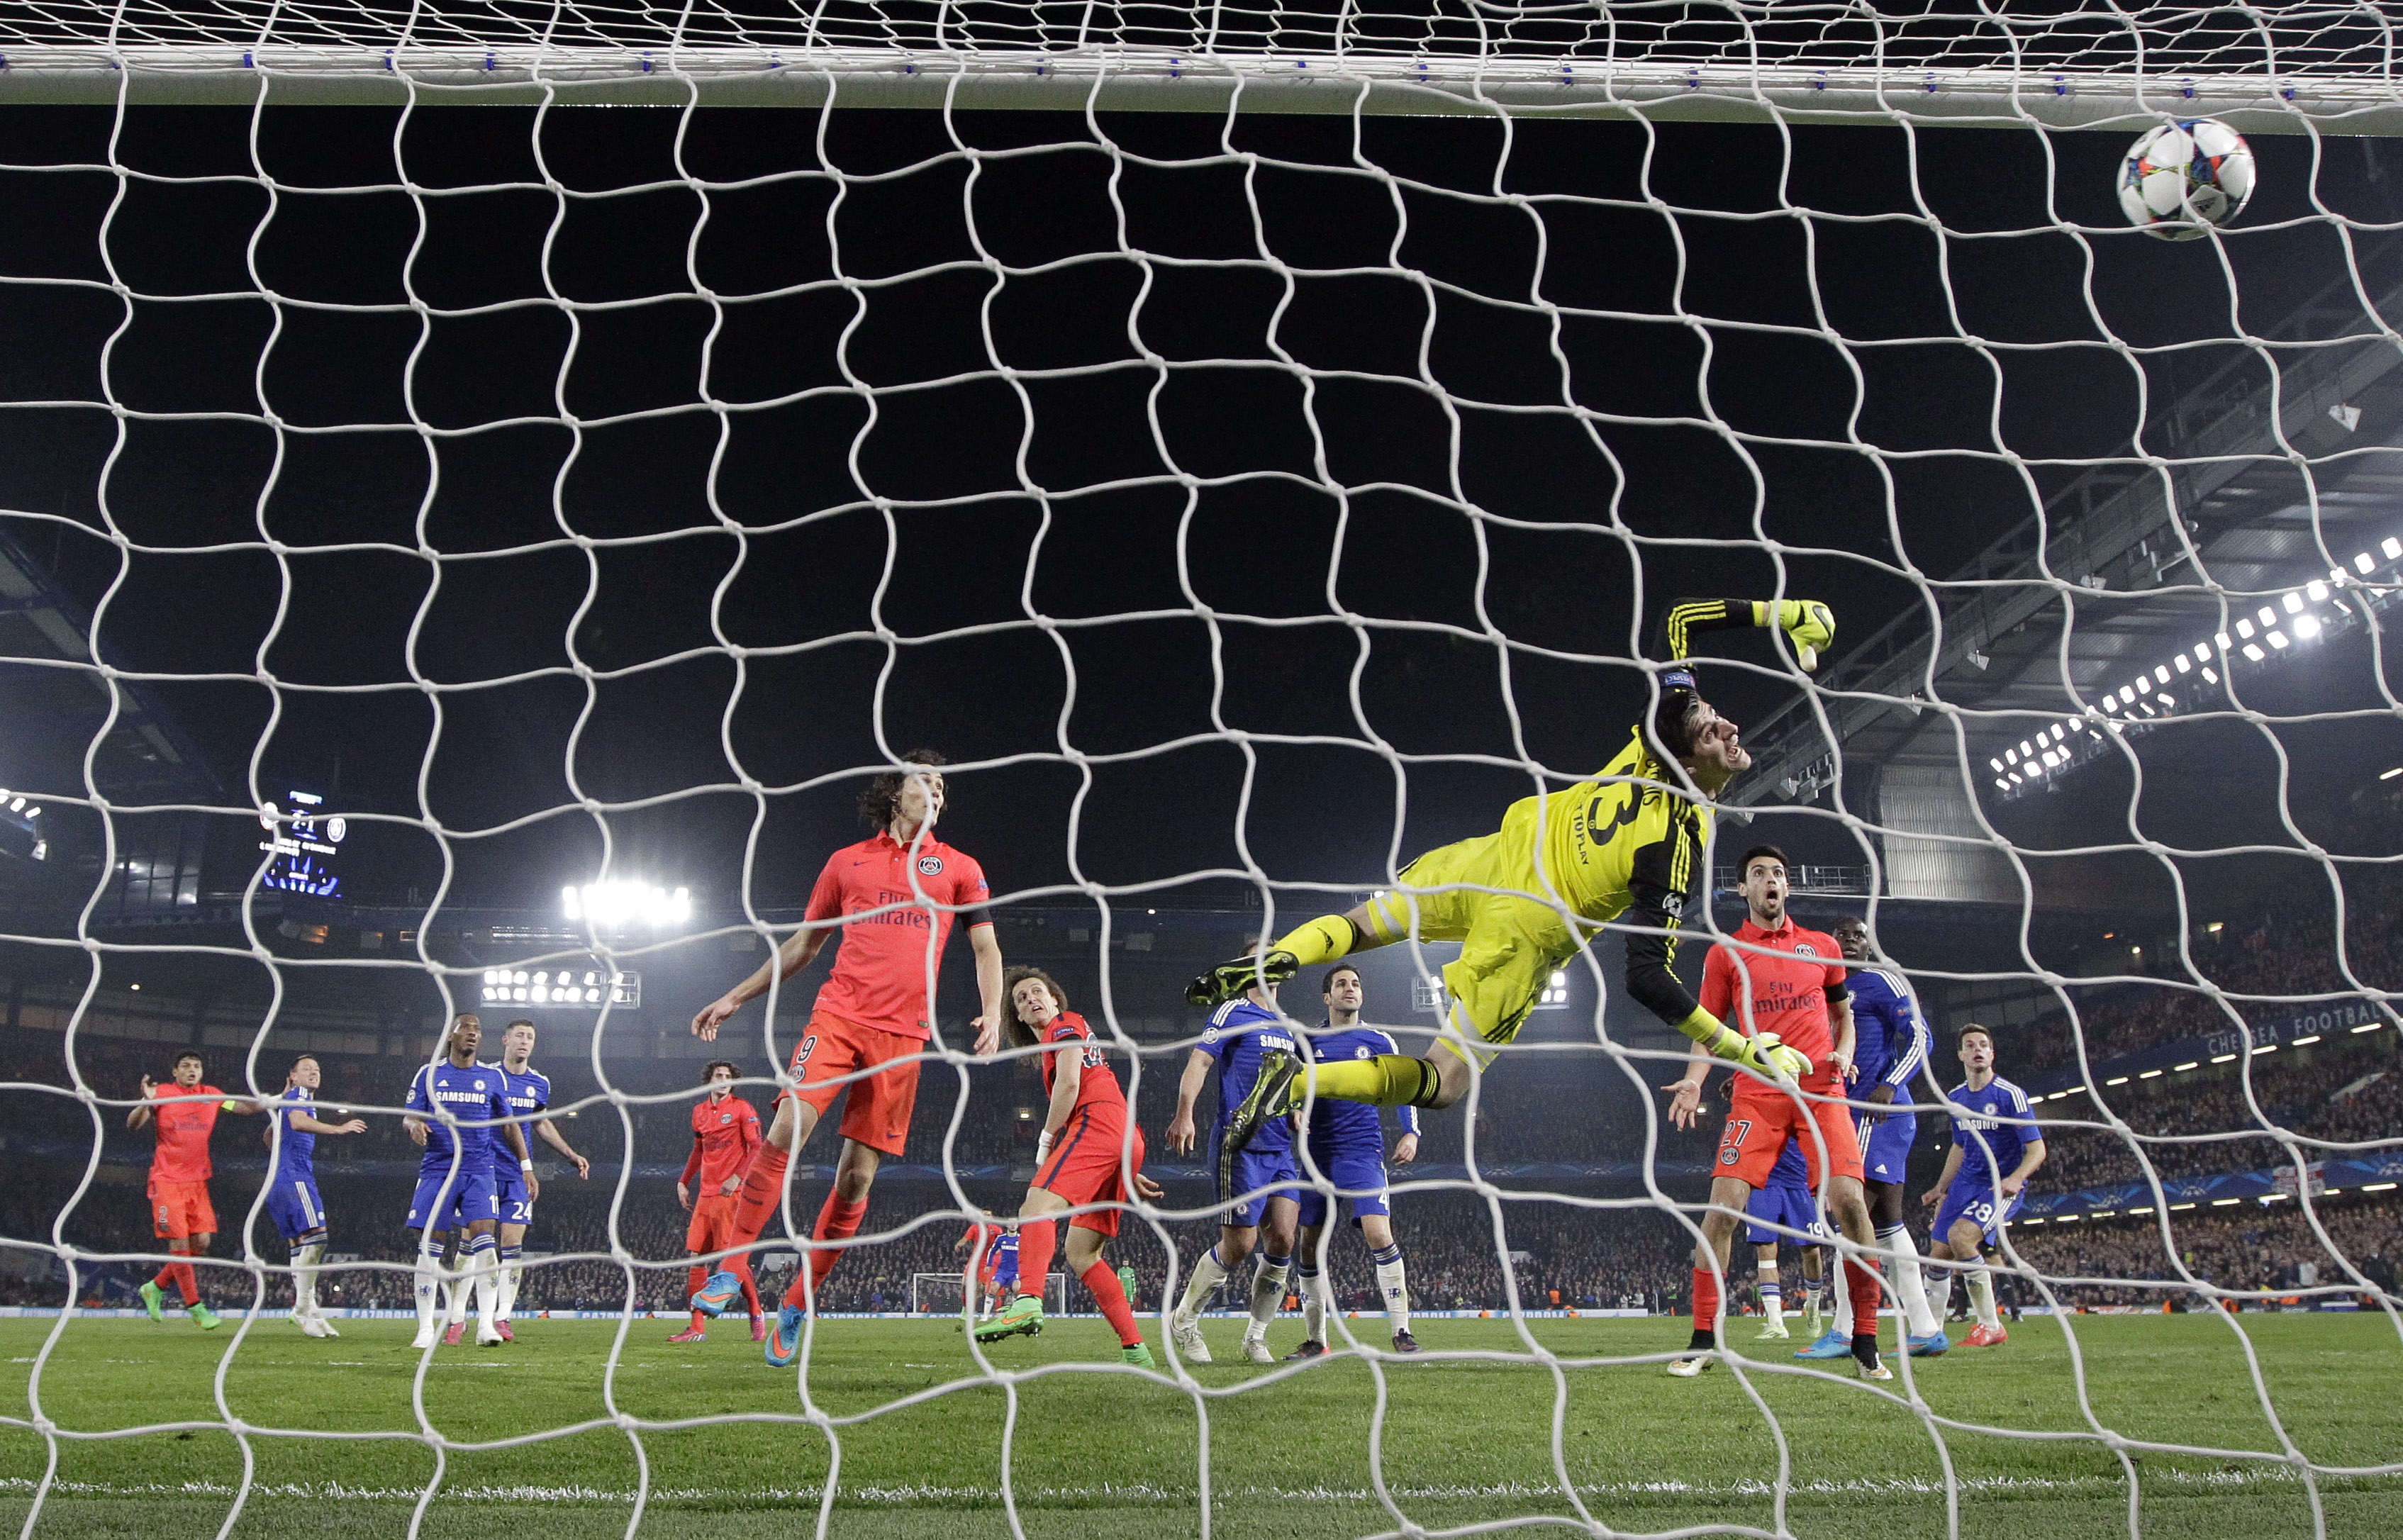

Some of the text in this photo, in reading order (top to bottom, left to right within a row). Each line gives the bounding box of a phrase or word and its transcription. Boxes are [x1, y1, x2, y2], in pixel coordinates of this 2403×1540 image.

[1752, 994, 1817, 1014] mirates
[2294, 1003, 2395, 1036] FOOTBAL
[796, 1035, 818, 1063] 9
[1260, 1034, 1295, 1052] SAMSU
[435, 1092, 486, 1104] SAMSUNG
[508, 1096, 536, 1108] SUNG
[1720, 1120, 1752, 1146] 27
[1378, 1187, 1388, 1210] 4
[159, 1206, 168, 1222] 2
[512, 1200, 533, 1221] 24
[1963, 1200, 1992, 1222] 28
[1806, 1222, 1824, 1238] 19
